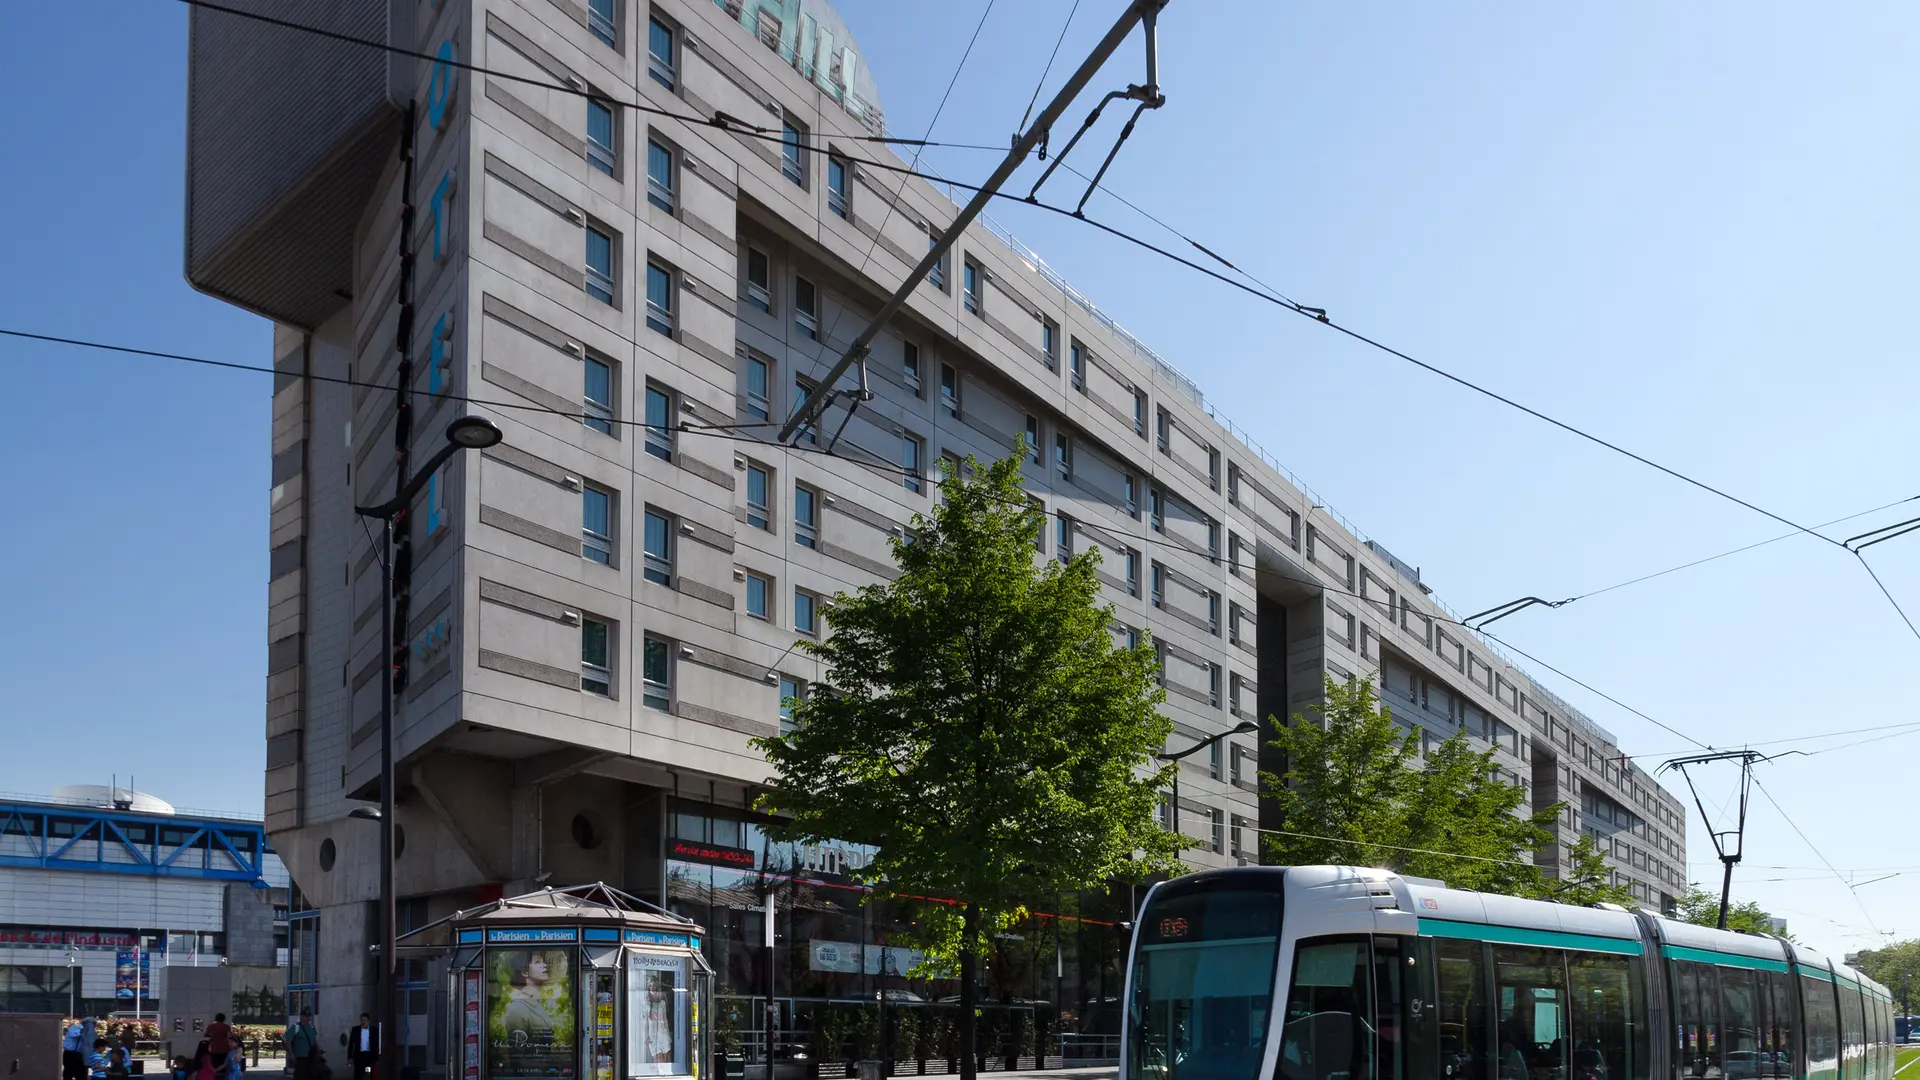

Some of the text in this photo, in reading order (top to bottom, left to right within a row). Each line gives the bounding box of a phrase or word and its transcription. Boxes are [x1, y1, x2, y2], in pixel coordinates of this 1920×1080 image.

[43, 932, 61, 944] de
[497, 931, 530, 941] Parisien
[541, 931, 573, 941] Parisien
